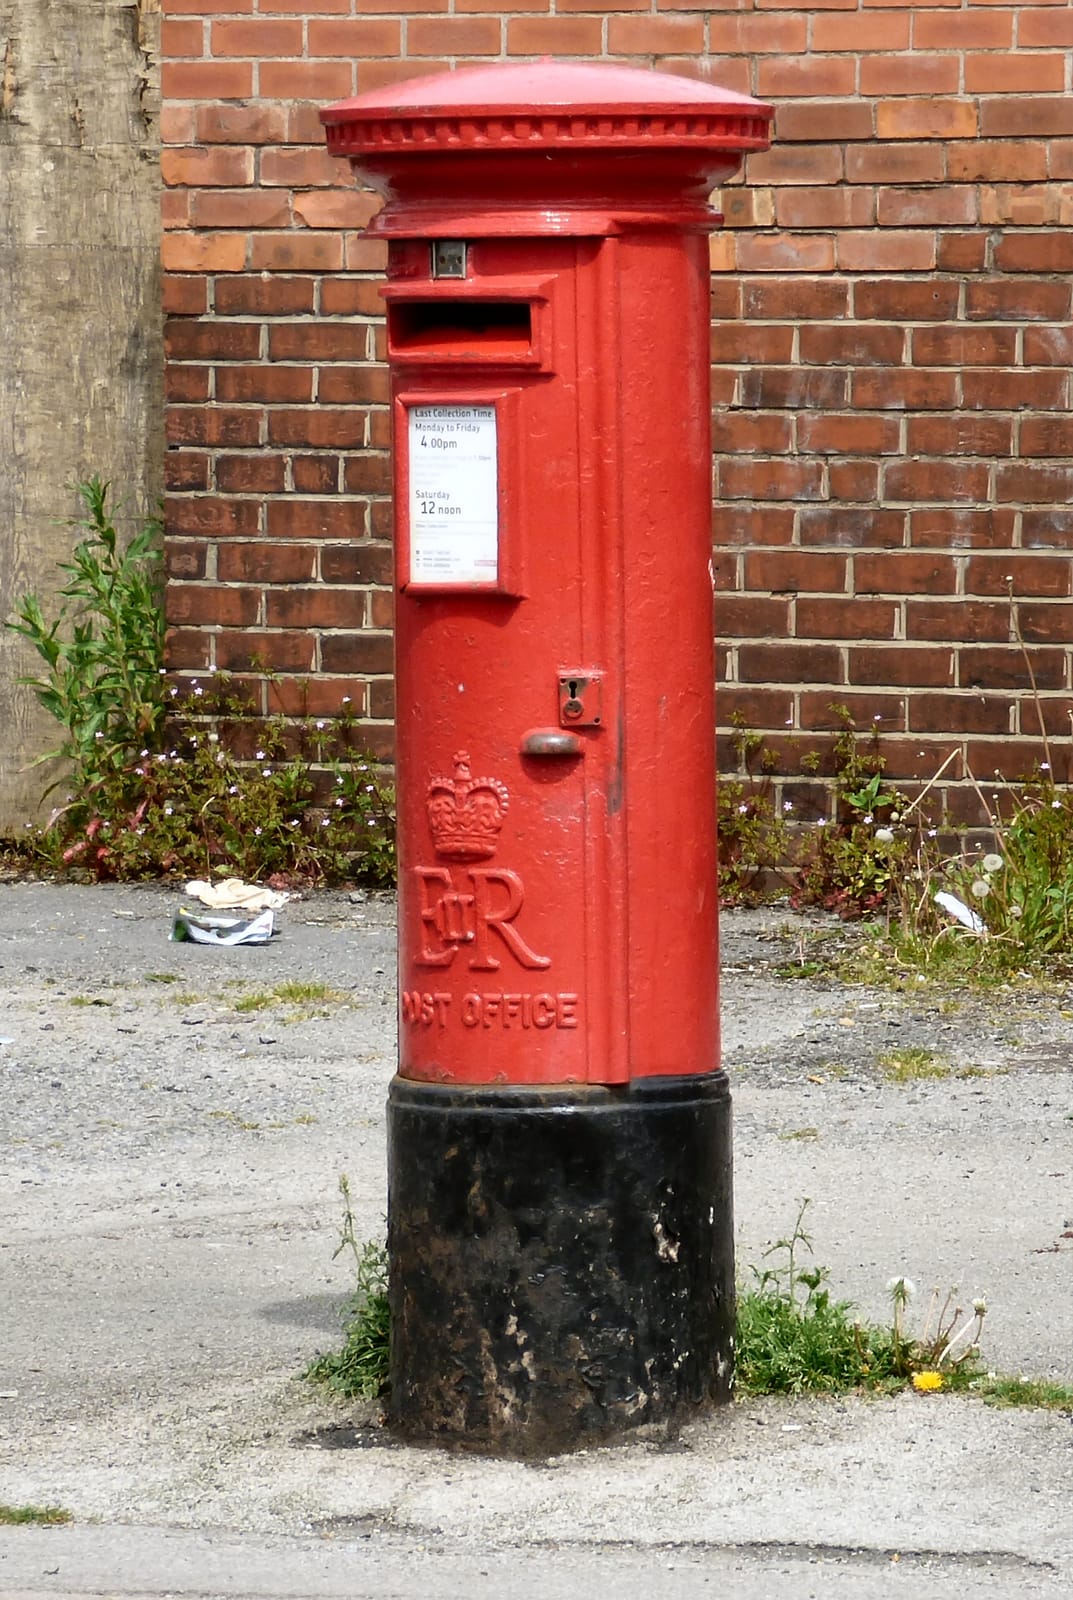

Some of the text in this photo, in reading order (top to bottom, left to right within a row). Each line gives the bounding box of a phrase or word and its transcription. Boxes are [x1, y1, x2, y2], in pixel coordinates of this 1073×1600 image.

[415, 408, 492, 418] Last Collection Time
[415, 423, 481, 434] Monday to Friday
[420, 435, 457, 450] 4.00pm
[415, 489, 450, 501] Saturday
[420, 501, 462, 515] 12 noon
[461, 992, 578, 1028] OFFICE
